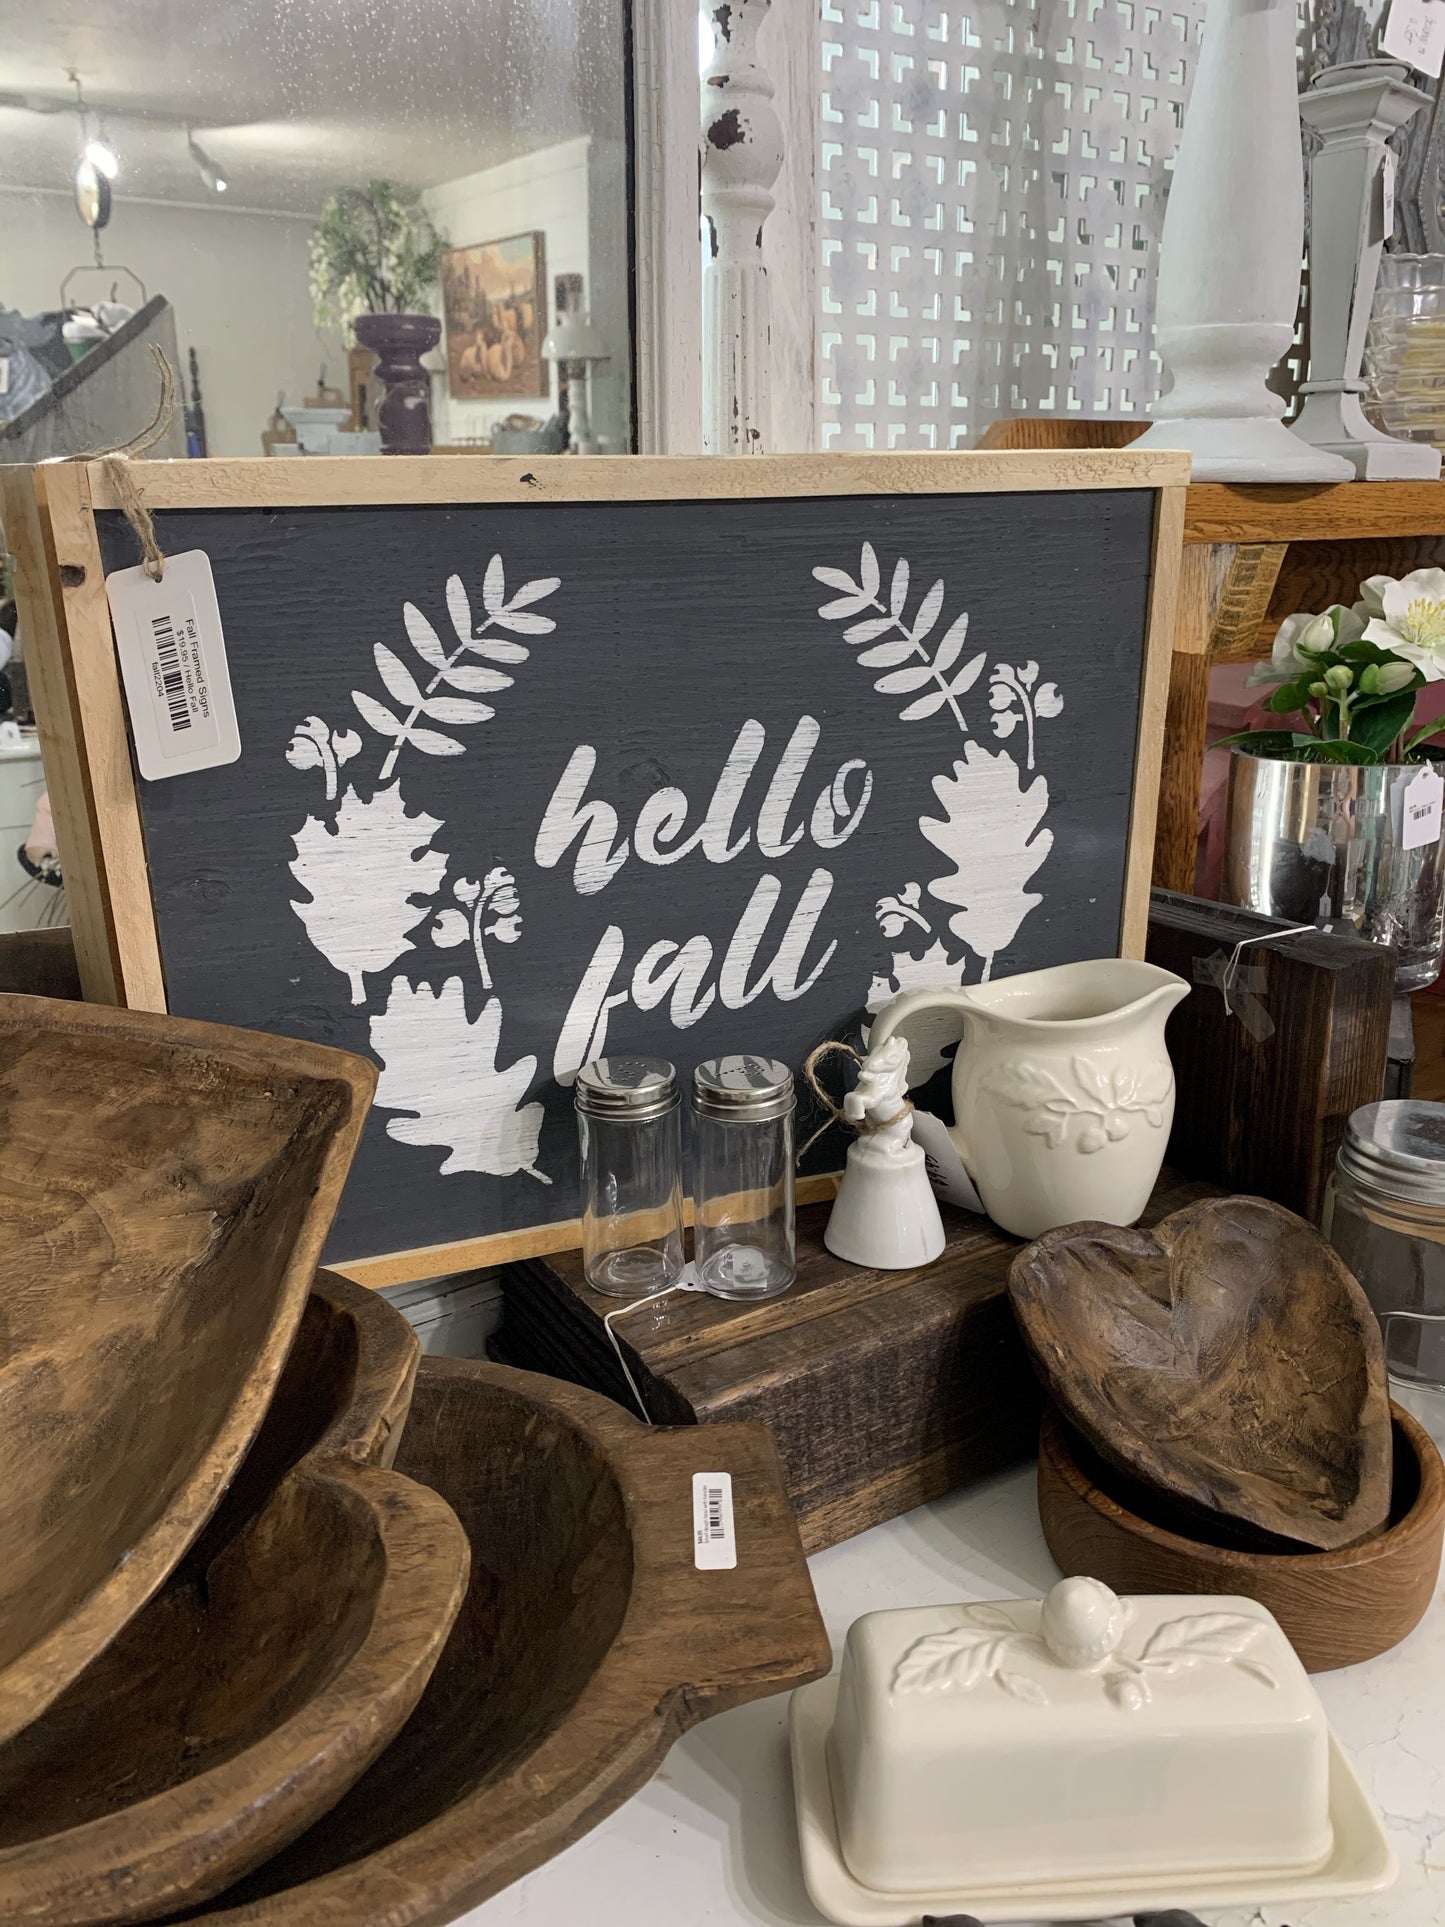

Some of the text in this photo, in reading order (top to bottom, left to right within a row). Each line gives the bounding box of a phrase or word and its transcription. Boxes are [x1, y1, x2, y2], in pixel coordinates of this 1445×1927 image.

[177, 630, 189, 662] $19.95
[151, 661, 164, 697] fall2204
[185, 618, 210, 718] Fall Framed Signs
[185, 670, 194, 694] Hello
[189, 695, 199, 713] Fall
[534, 715, 873, 895] hello
[553, 867, 838, 1087] fall
